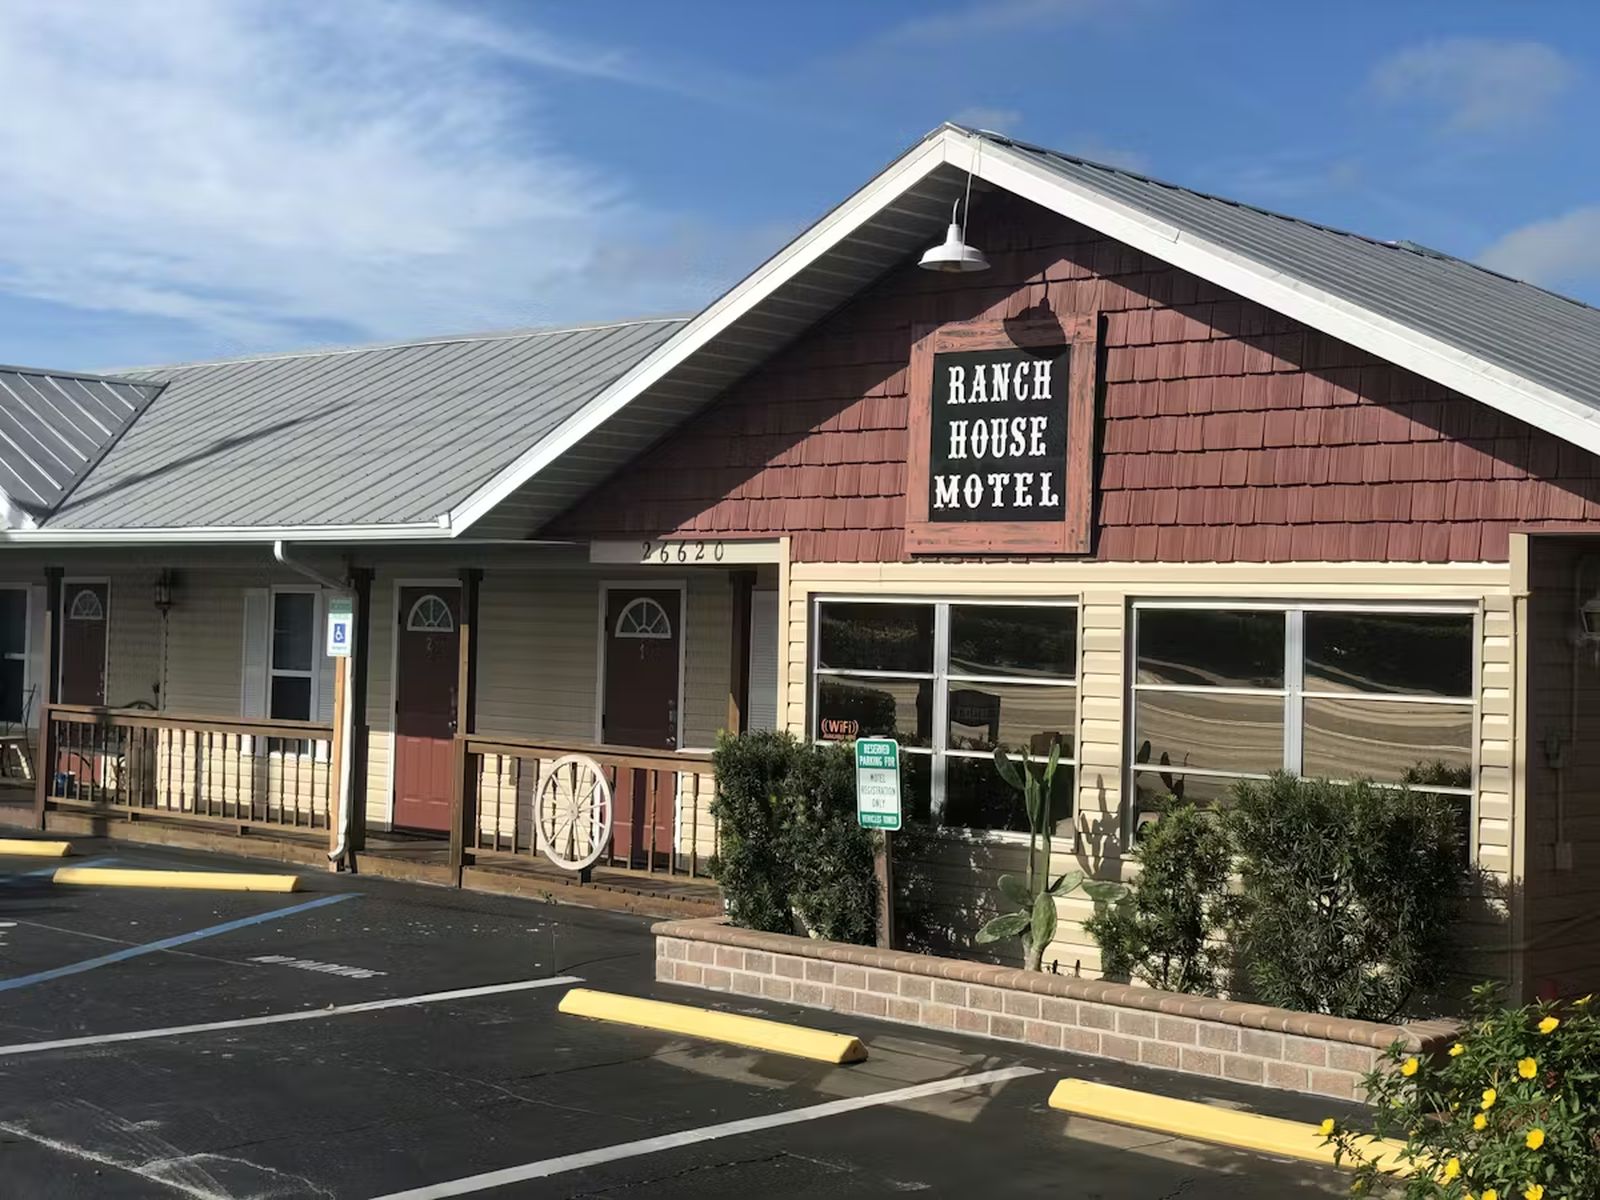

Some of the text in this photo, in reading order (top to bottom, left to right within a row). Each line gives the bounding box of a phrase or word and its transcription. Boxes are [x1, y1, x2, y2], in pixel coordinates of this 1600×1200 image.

[947, 360, 1053, 404] RANCH
[948, 416, 1048, 459] HOUSE
[933, 472, 1059, 509] MOTEL
[642, 540, 724, 563] 26620
[828, 719, 852, 733] WiFi
[859, 755, 896, 768] PARKING FOR
[872, 798, 886, 809] ONLY
